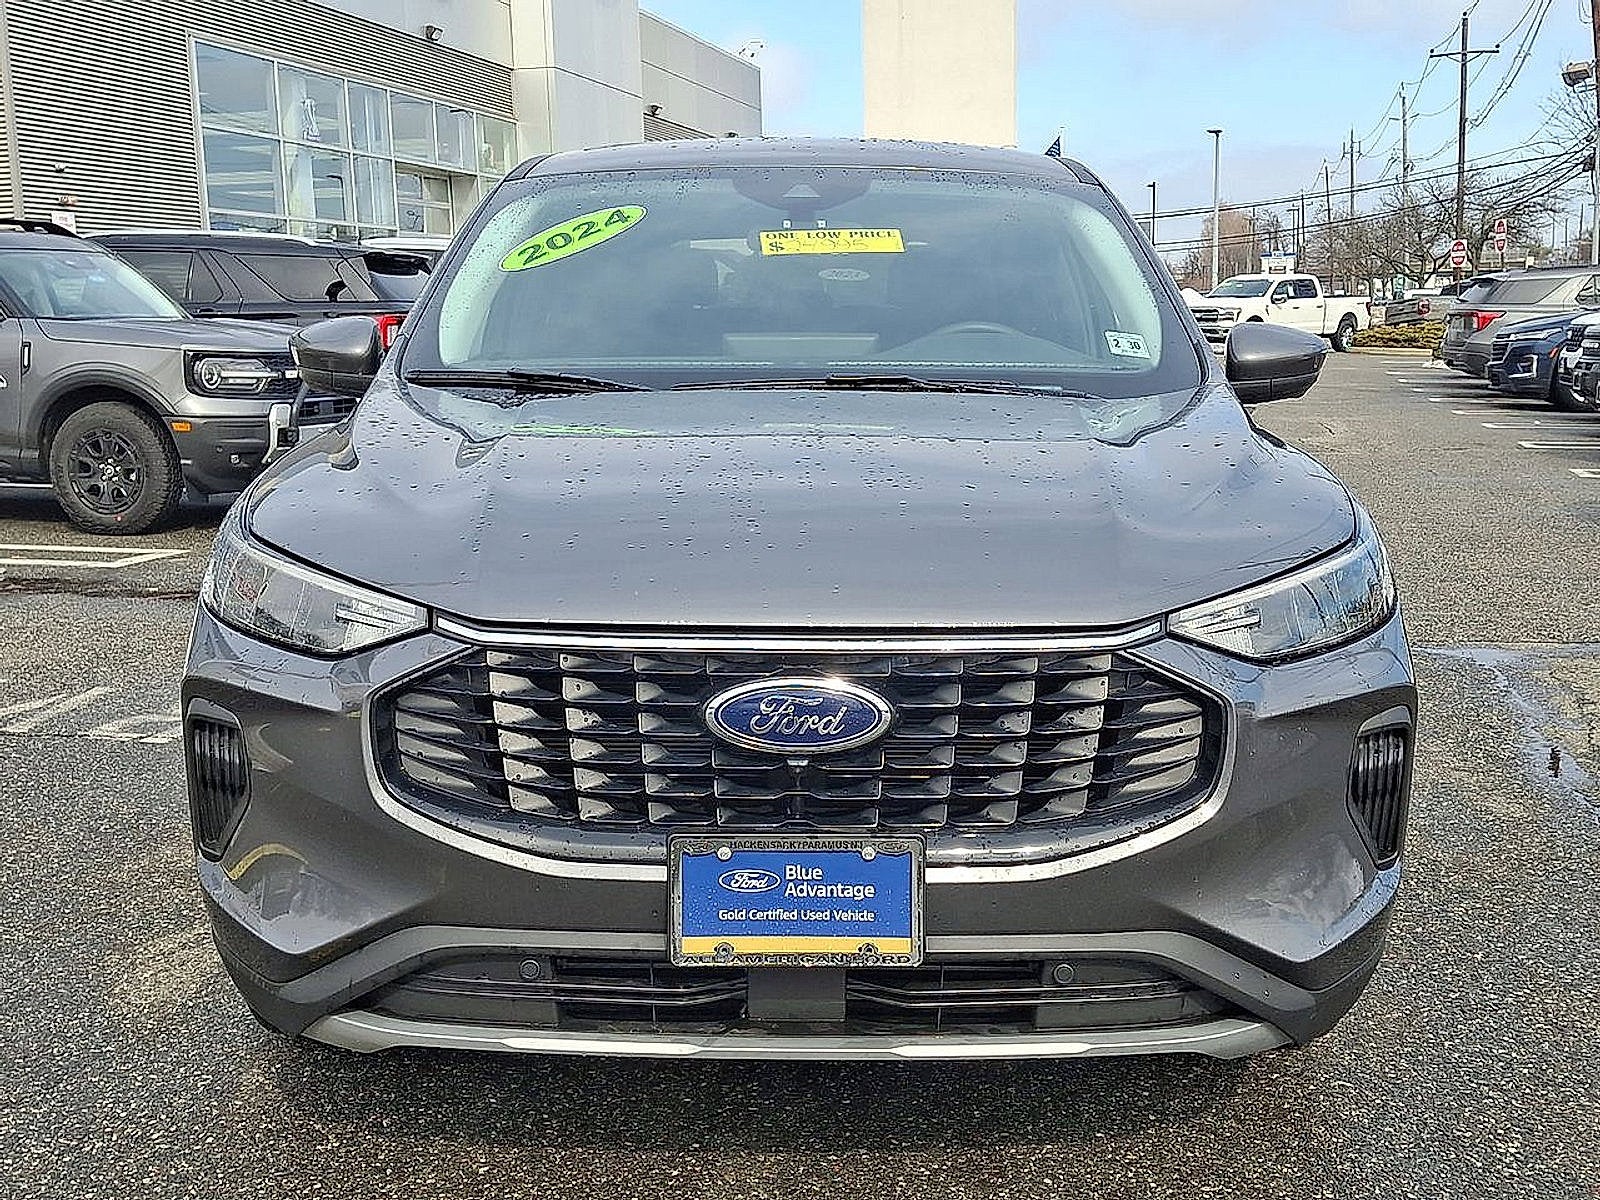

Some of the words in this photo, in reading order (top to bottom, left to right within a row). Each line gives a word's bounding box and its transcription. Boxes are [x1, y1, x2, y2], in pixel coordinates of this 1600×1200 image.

[517, 209, 630, 266] 2024
[766, 231, 798, 239] ONE
[807, 231, 841, 239] LOW
[751, 694, 847, 735] Ford
[730, 872, 769, 889] Ford
[785, 865, 823, 880] Blue
[784, 882, 875, 900] Advantage
[718, 909, 746, 921] Gold
[749, 909, 798, 921] Certified
[801, 909, 830, 921] Used
[833, 909, 875, 921] Vehicle
